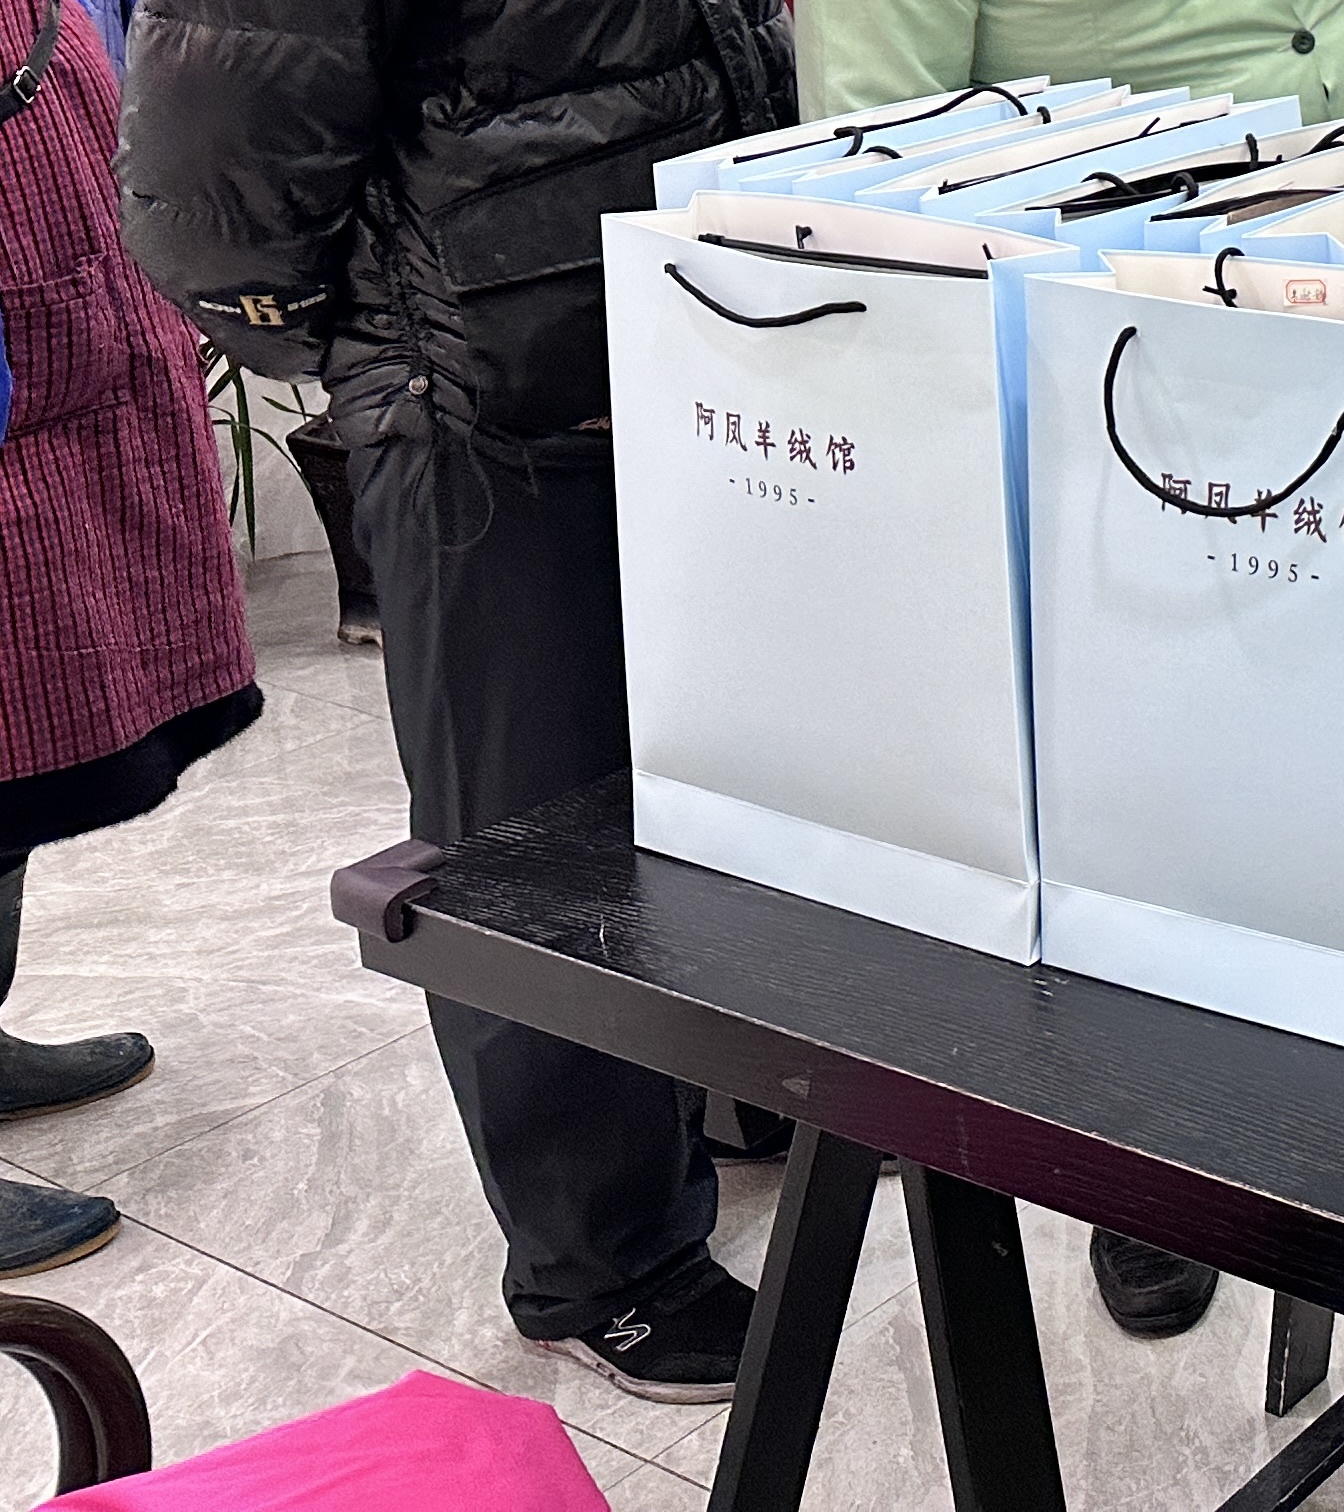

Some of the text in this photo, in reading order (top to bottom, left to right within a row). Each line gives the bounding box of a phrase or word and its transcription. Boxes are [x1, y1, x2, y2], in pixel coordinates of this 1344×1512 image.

[695, 401, 857, 474] 阿凤羊绒馆
